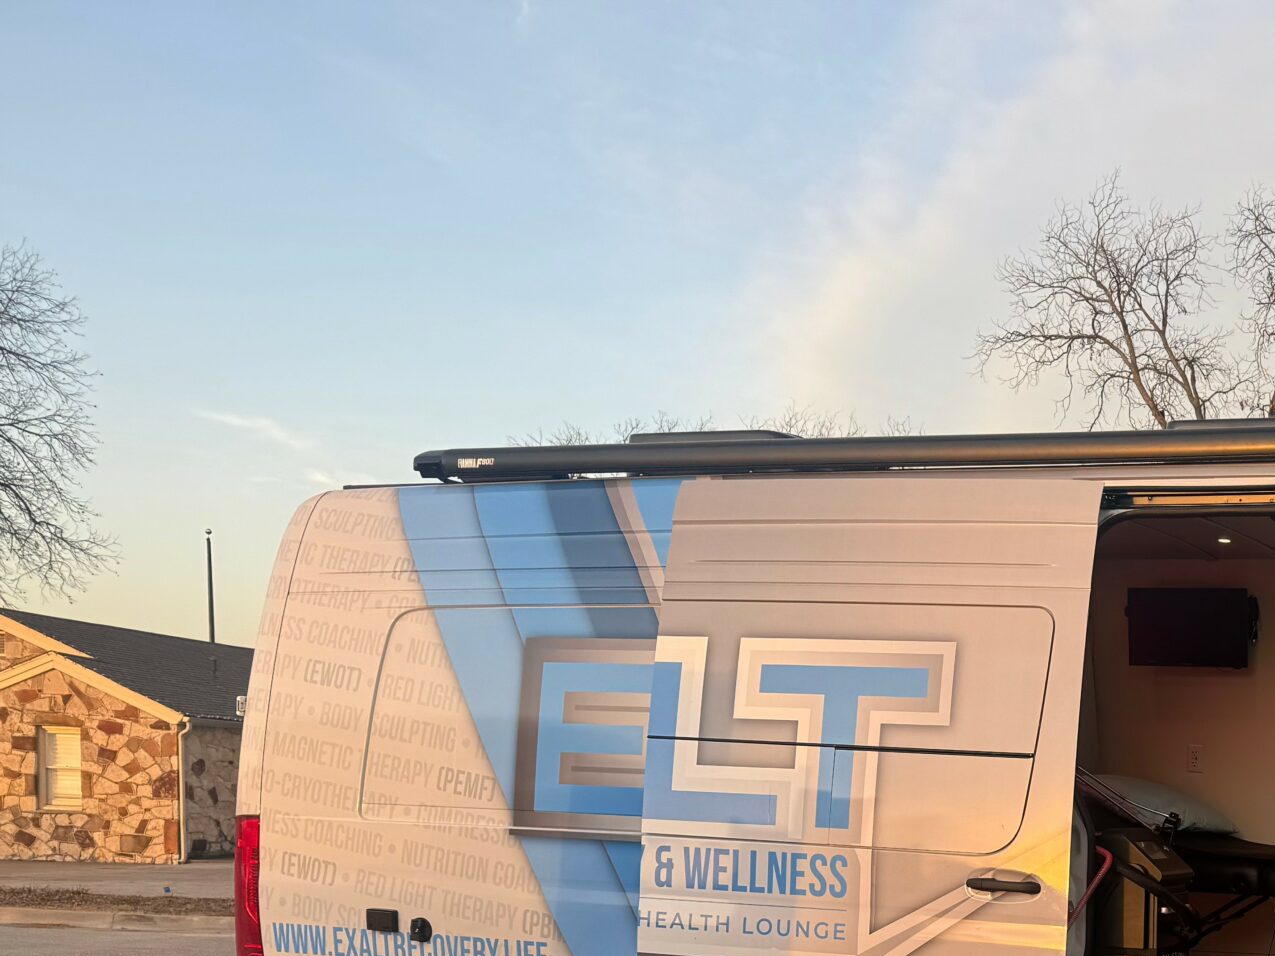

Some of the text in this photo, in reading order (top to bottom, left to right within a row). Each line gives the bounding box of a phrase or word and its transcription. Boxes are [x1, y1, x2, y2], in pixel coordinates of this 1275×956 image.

[319, 543, 392, 577] THERAPY
[306, 621, 387, 658] COACHING
[303, 658, 362, 693] (EWOT)
[381, 673, 416, 703] RED
[318, 700, 364, 733] BODY
[371, 711, 457, 752] SCULPTING
[269, 730, 354, 771] MAGNETIC
[358, 749, 436, 789] THERAPY
[304, 818, 384, 859] COACHING
[401, 838, 490, 884] NUTRITION
[654, 845, 849, 899] & WELLNESS
[281, 851, 338, 887] (EWOT)
[353, 869, 390, 900] RED
[390, 873, 438, 912] LIGHT
[441, 888, 519, 931] THERAPY
[291, 892, 334, 925] BODY
[637, 910, 847, 941] HEALTH LOUNGE
